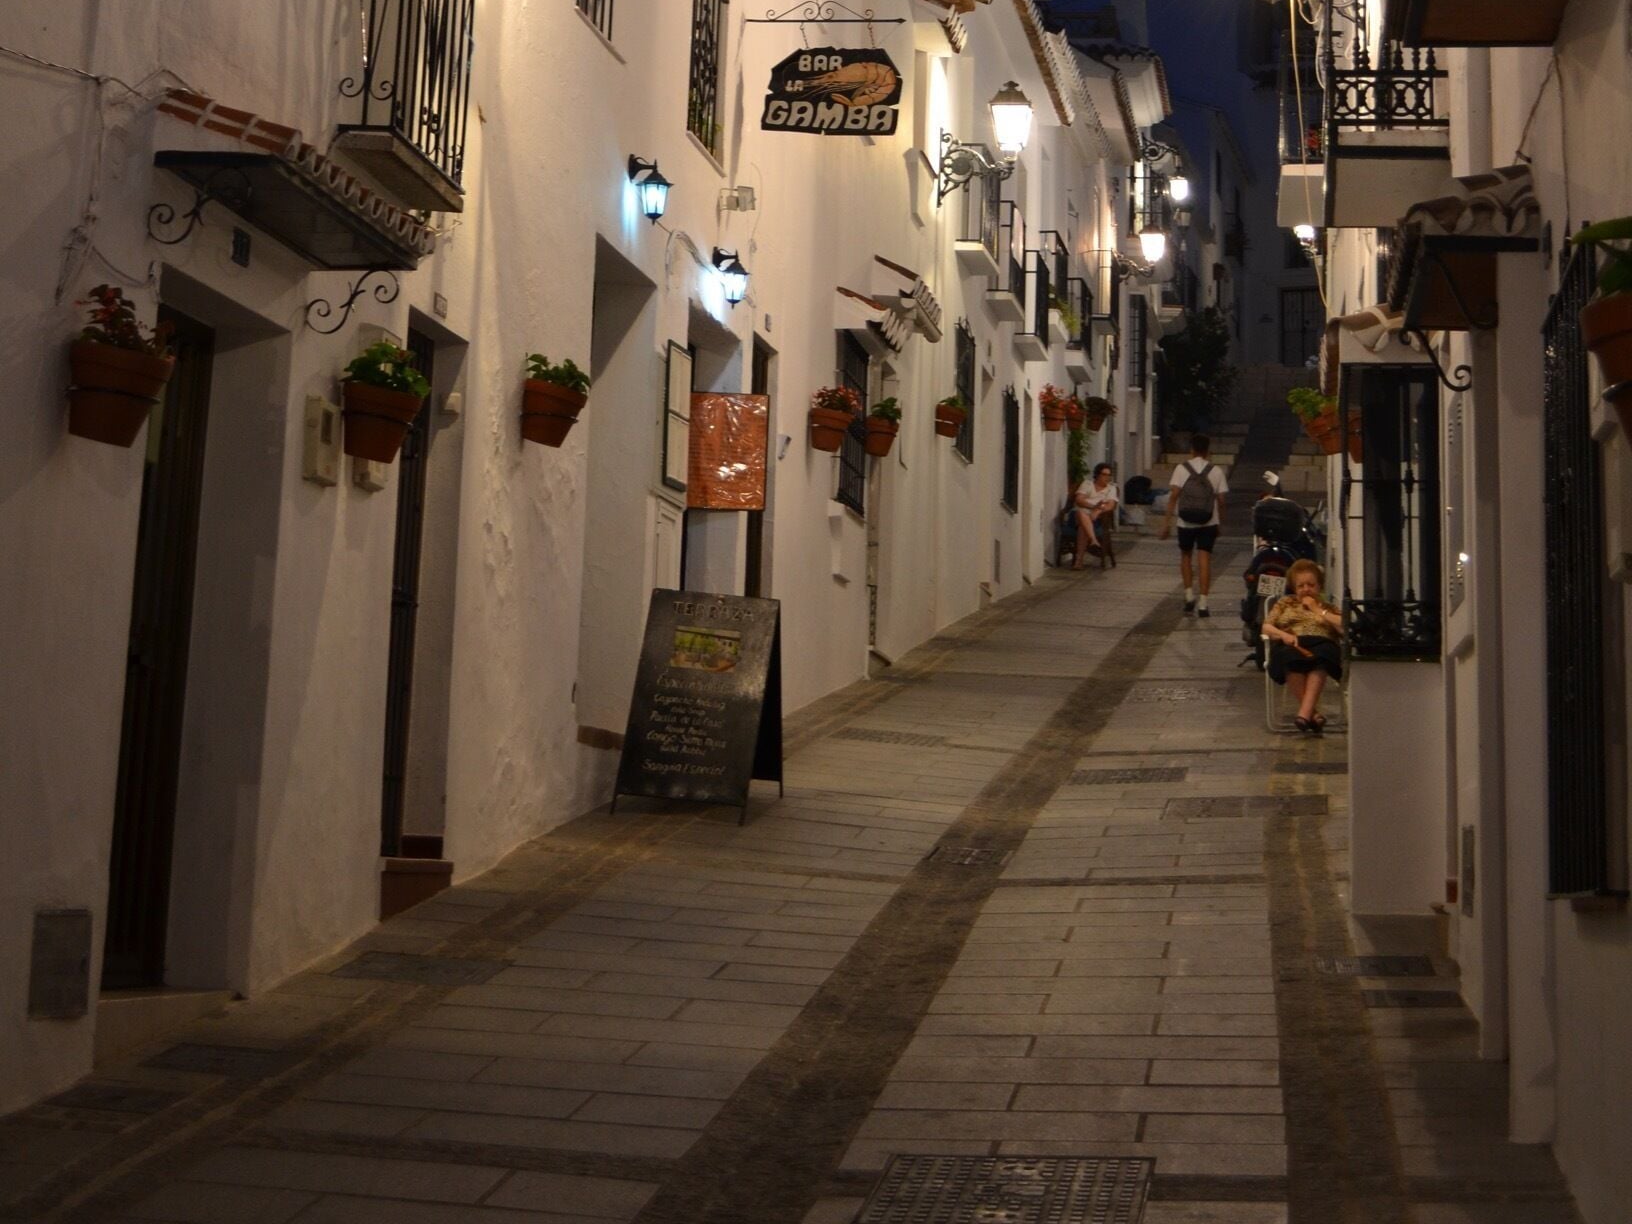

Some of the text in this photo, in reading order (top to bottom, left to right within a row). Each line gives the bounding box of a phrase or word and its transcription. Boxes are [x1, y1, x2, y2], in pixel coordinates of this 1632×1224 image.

[798, 54, 843, 72] BAR
[785, 79, 804, 92] LA
[765, 99, 893, 131] GAMBA
[672, 600, 754, 622] TERRAZA
